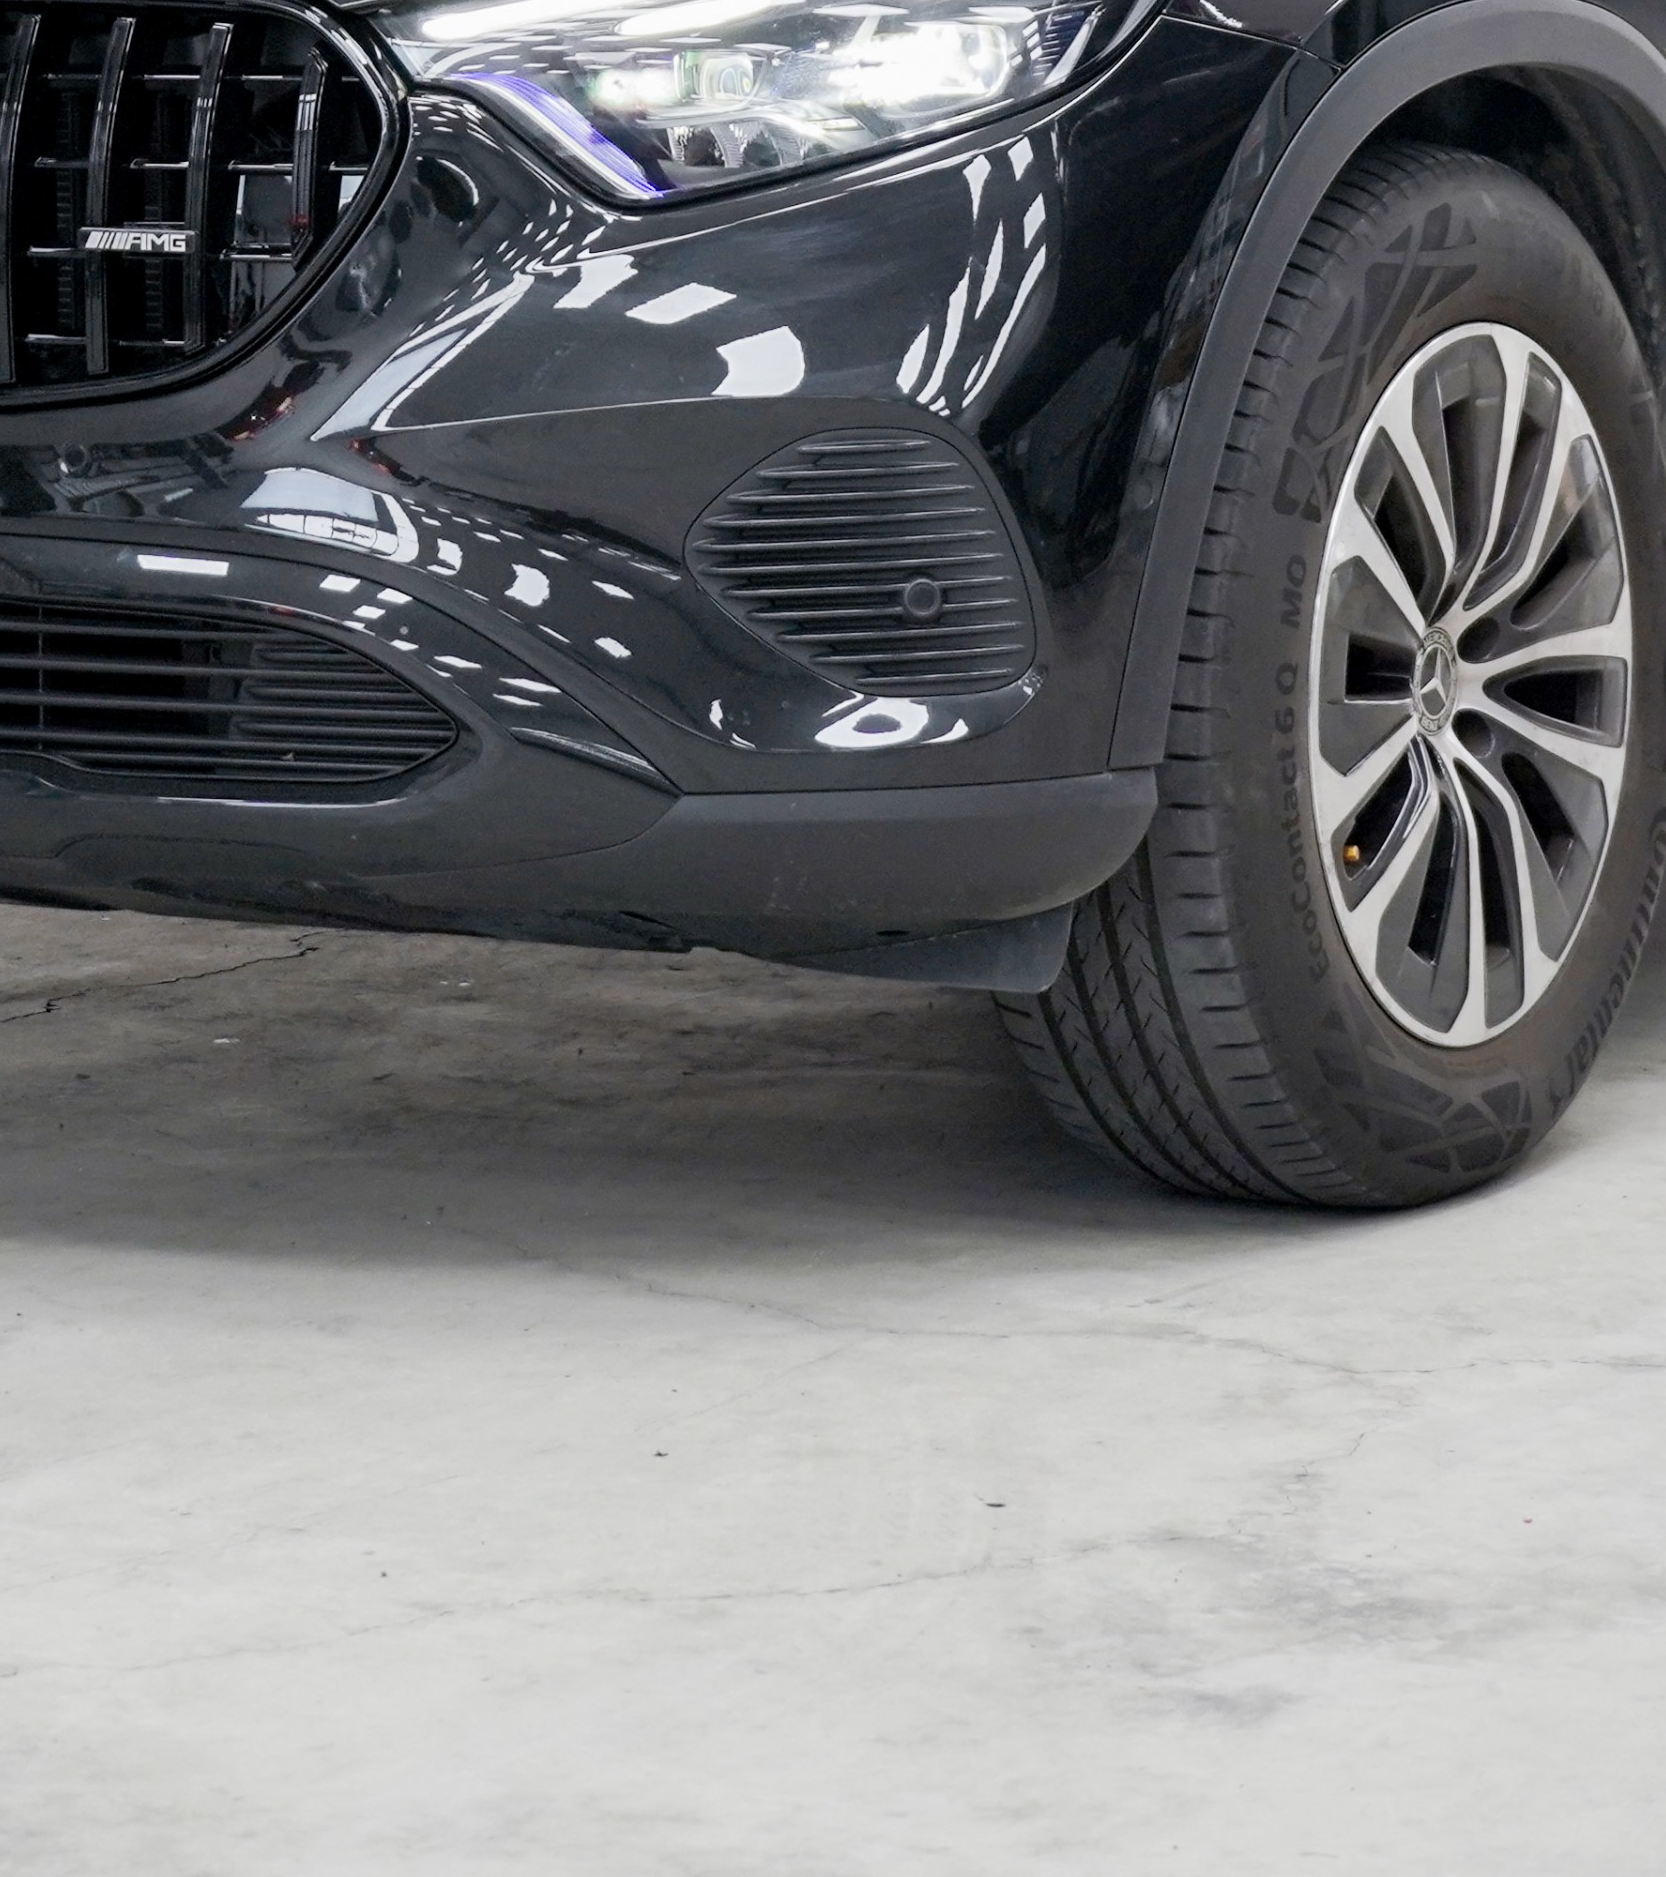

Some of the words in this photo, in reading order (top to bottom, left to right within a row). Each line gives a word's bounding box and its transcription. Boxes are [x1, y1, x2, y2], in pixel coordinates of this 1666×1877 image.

[125, 232, 186, 253] AMG
[1278, 553, 1308, 629] MO
[1273, 661, 1299, 696] Q
[1273, 707, 1296, 733] 6
[1275, 745, 1331, 984] EcoContact
